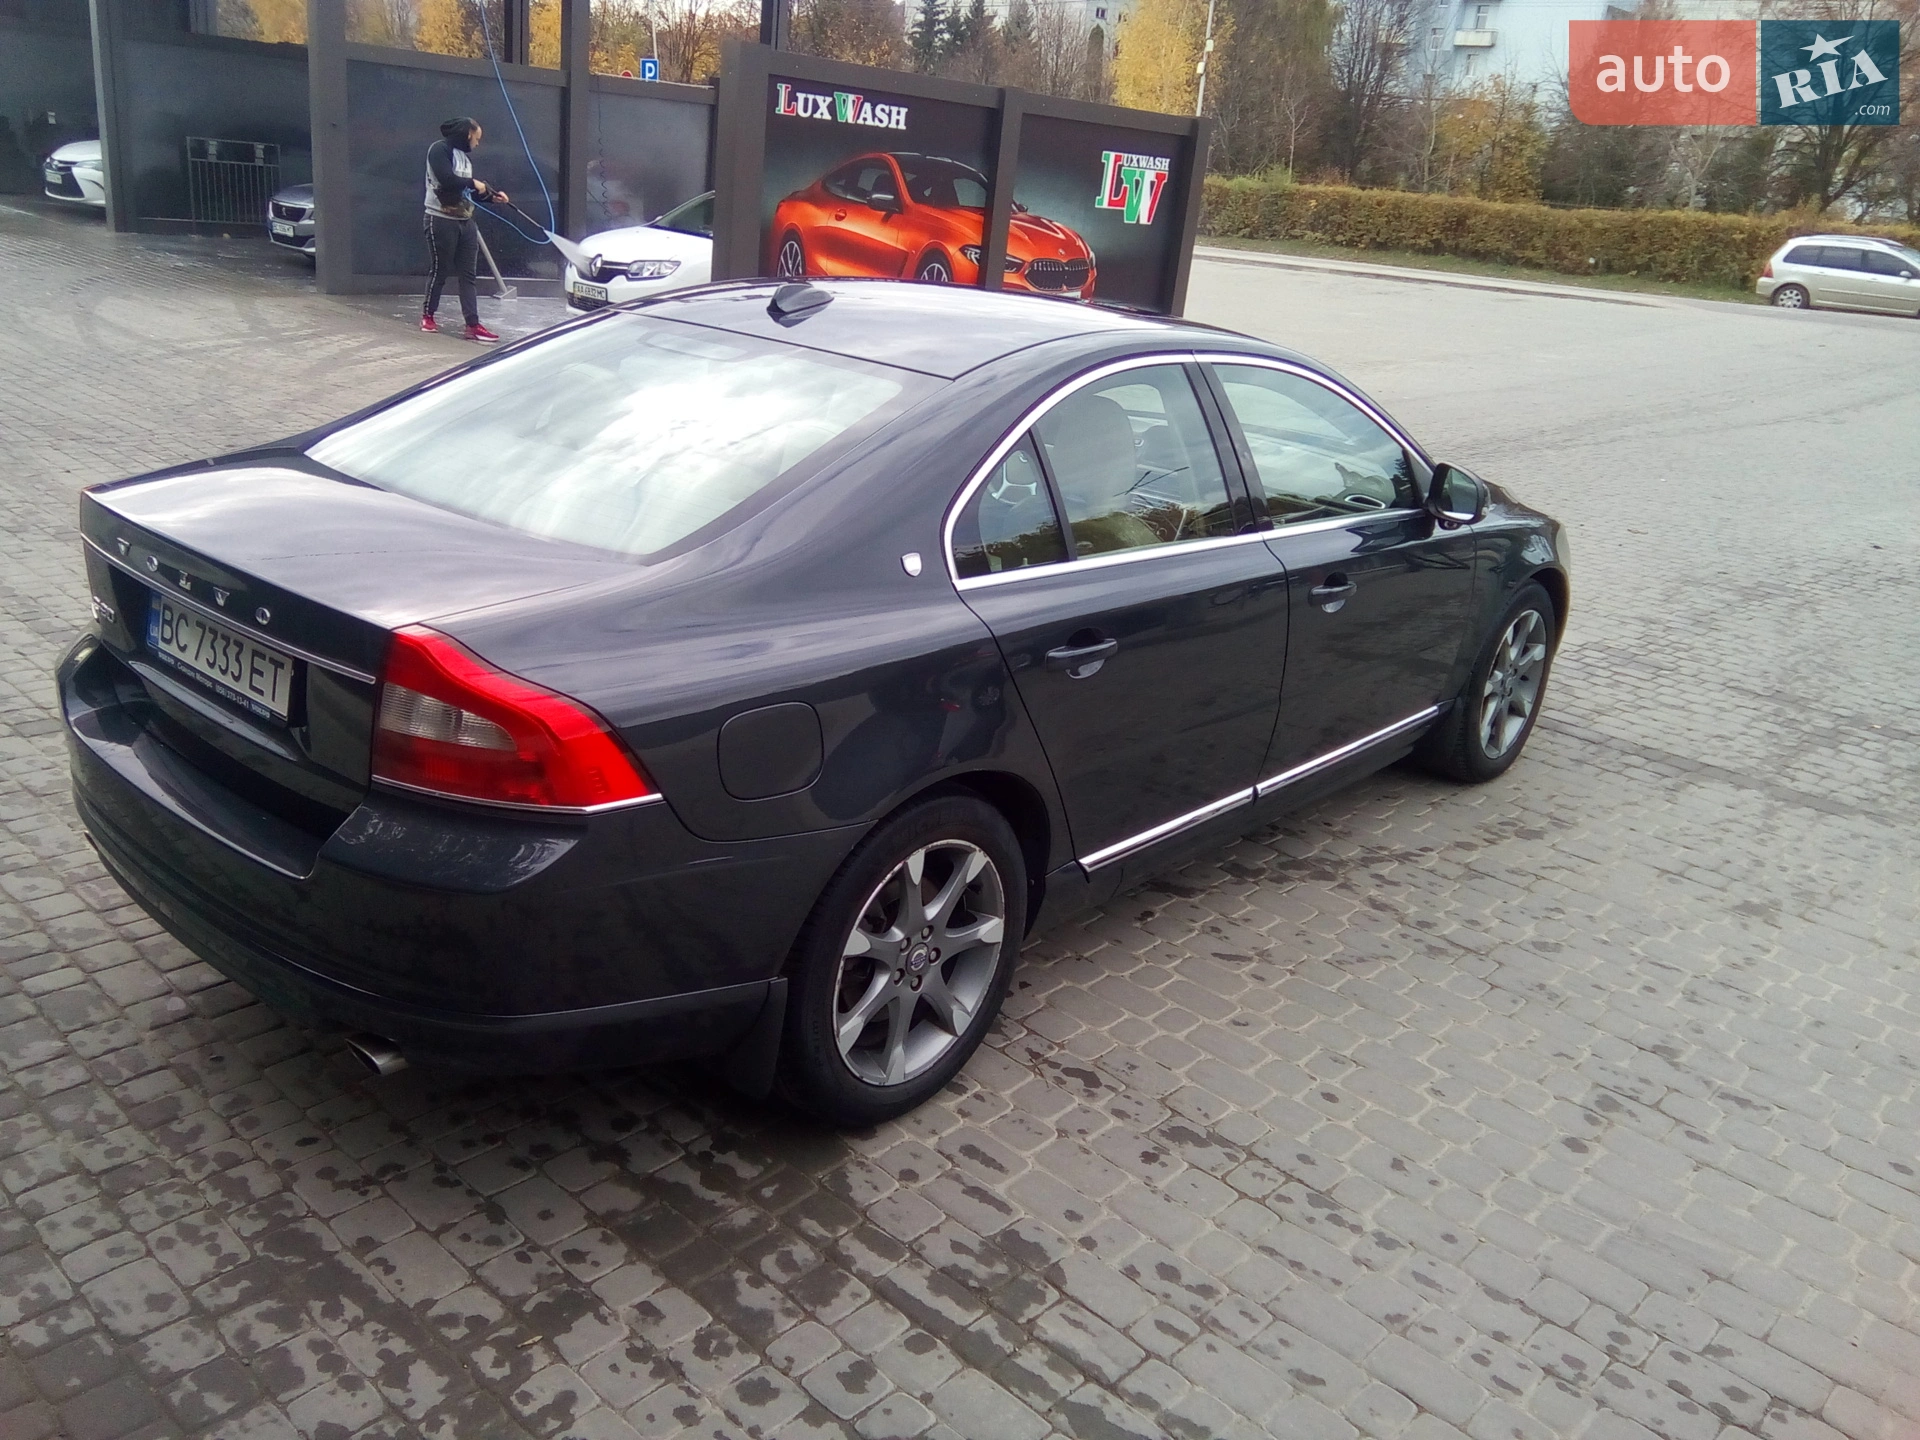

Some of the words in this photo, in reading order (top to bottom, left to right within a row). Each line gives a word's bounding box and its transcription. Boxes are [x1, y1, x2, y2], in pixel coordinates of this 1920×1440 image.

[645, 62, 656, 80] P
[117, 537, 271, 626] VOLVO
[160, 603, 189, 653] BC
[194, 620, 245, 683] 7333
[249, 649, 286, 703] ET
